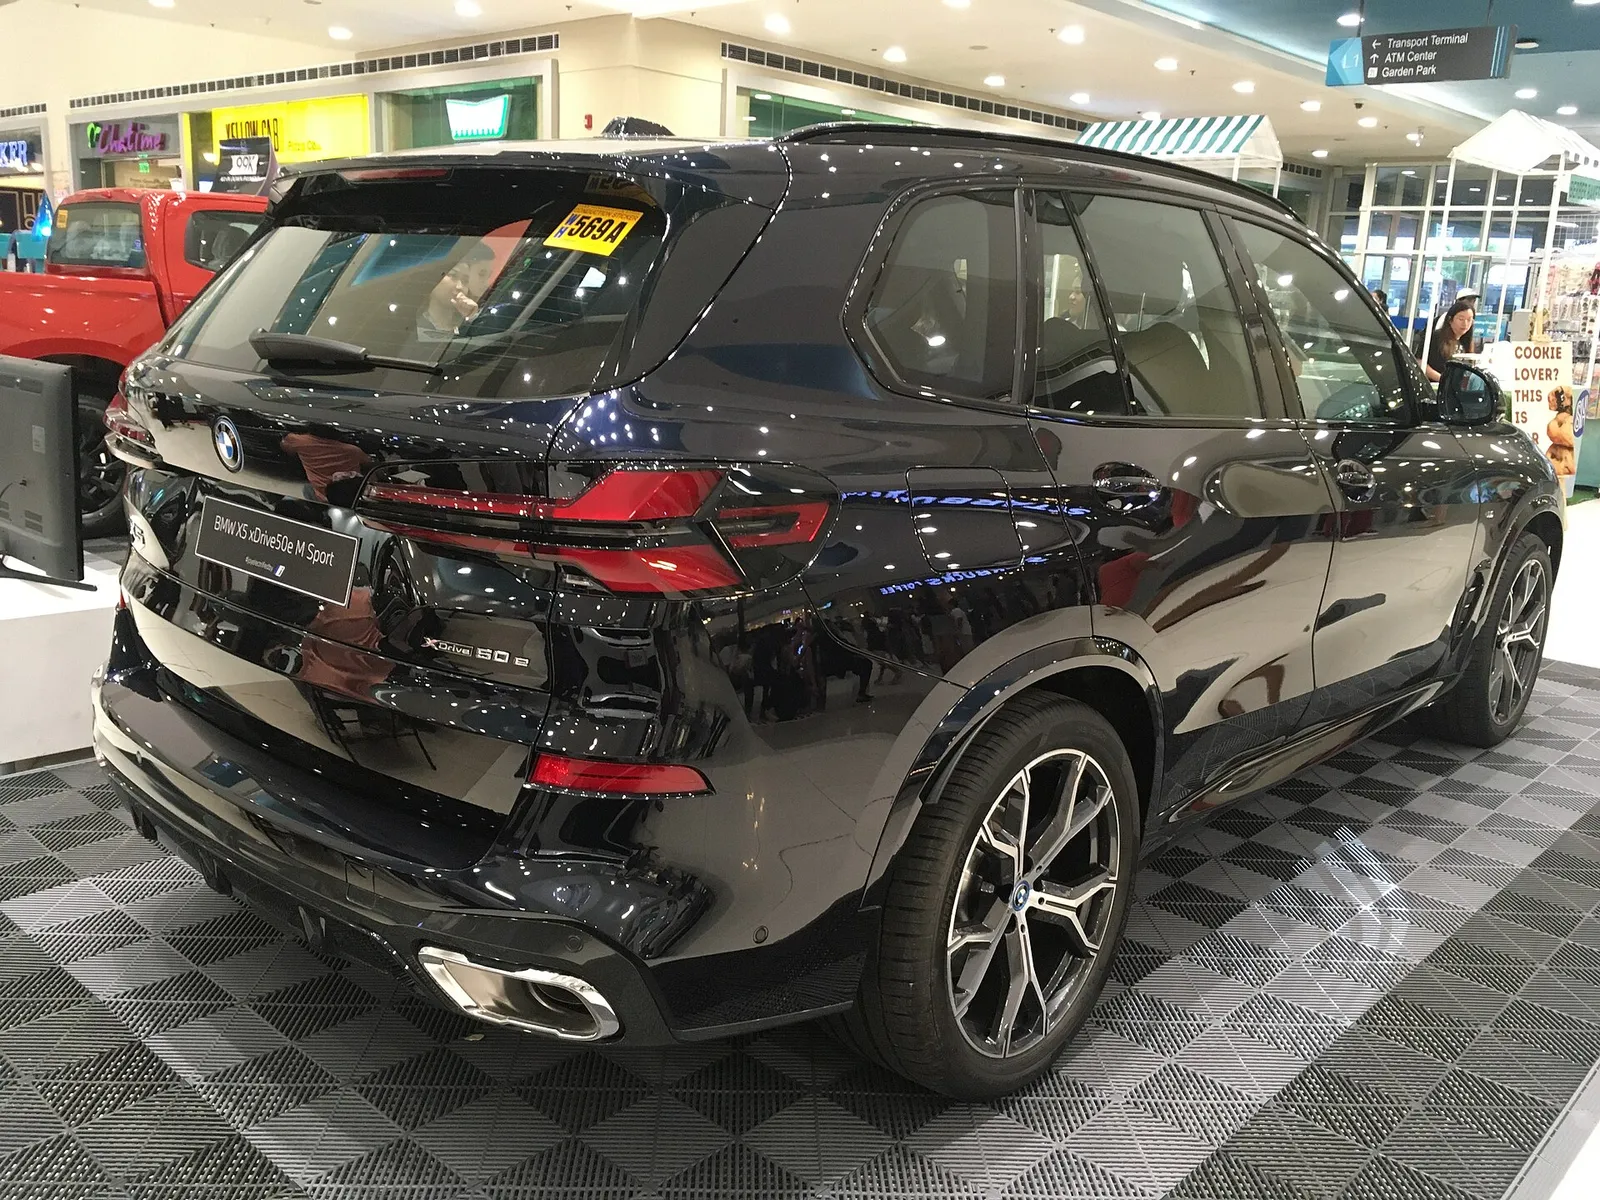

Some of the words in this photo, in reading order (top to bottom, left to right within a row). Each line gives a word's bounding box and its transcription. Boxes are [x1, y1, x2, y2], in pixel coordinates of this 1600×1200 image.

[1387, 34, 1428, 49] Transport
[1430, 32, 1469, 46] Terminal
[1384, 52, 1404, 63] ATM
[1406, 50, 1438, 62] Center
[1381, 66, 1414, 78] Garden
[1416, 65, 1437, 76] Park
[567, 215, 628, 244] 569A
[1514, 346, 1562, 360] COOKIE
[1514, 367, 1559, 381] LOVER?
[1514, 389, 1543, 403] THIS
[1515, 411, 1528, 424] IS
[213, 514, 237, 535] BMW
[235, 521, 249, 540] X5
[248, 526, 294, 555] xDrive50e
[295, 539, 306, 558] M
[306, 542, 335, 567] Sport
